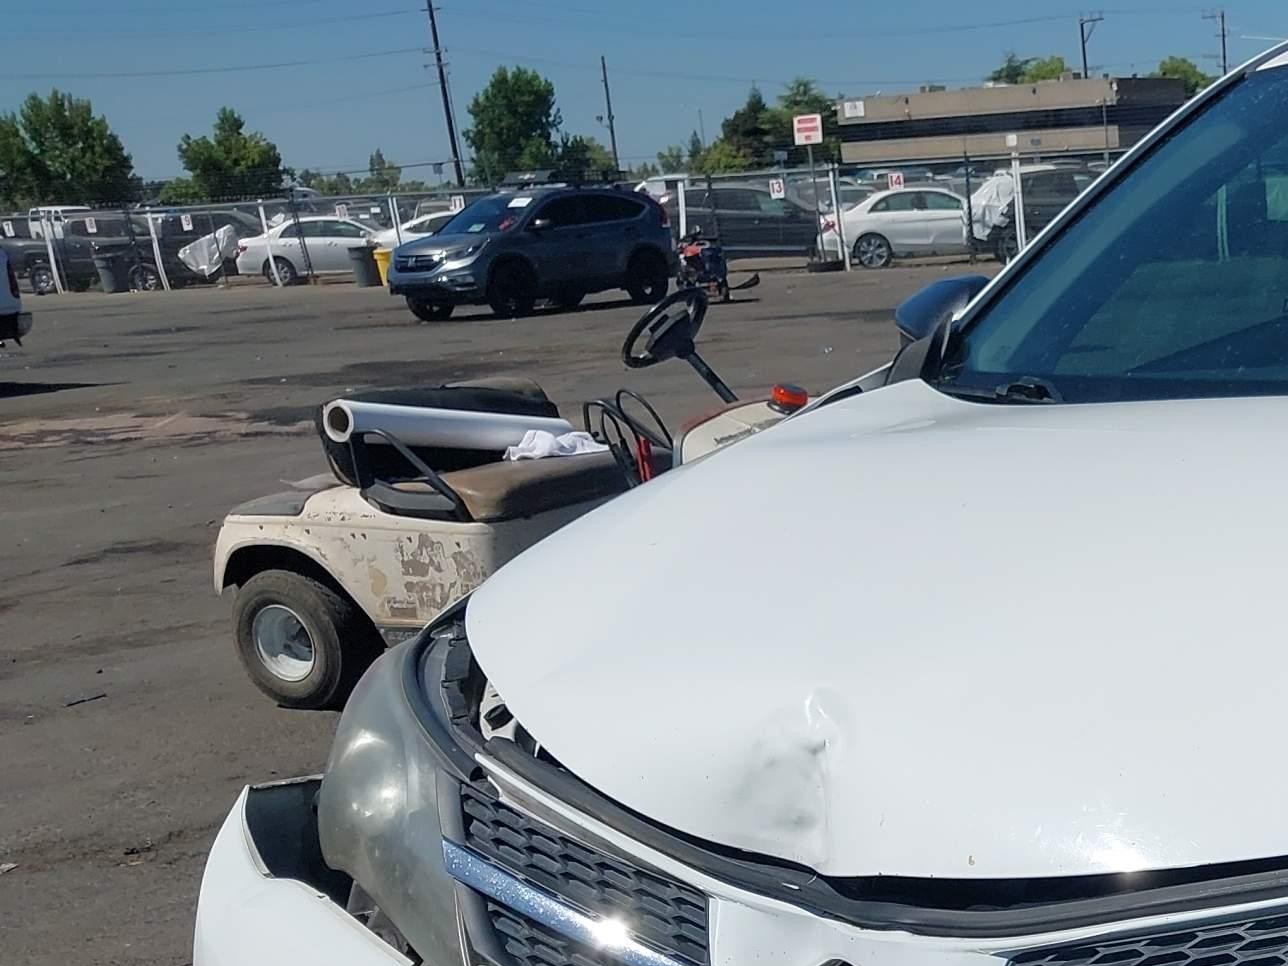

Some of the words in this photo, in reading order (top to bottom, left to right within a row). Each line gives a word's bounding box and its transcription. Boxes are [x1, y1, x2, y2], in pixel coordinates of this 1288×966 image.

[889, 175, 902, 187] 14
[770, 181, 783, 194] 13
[5, 222, 11, 232] 7
